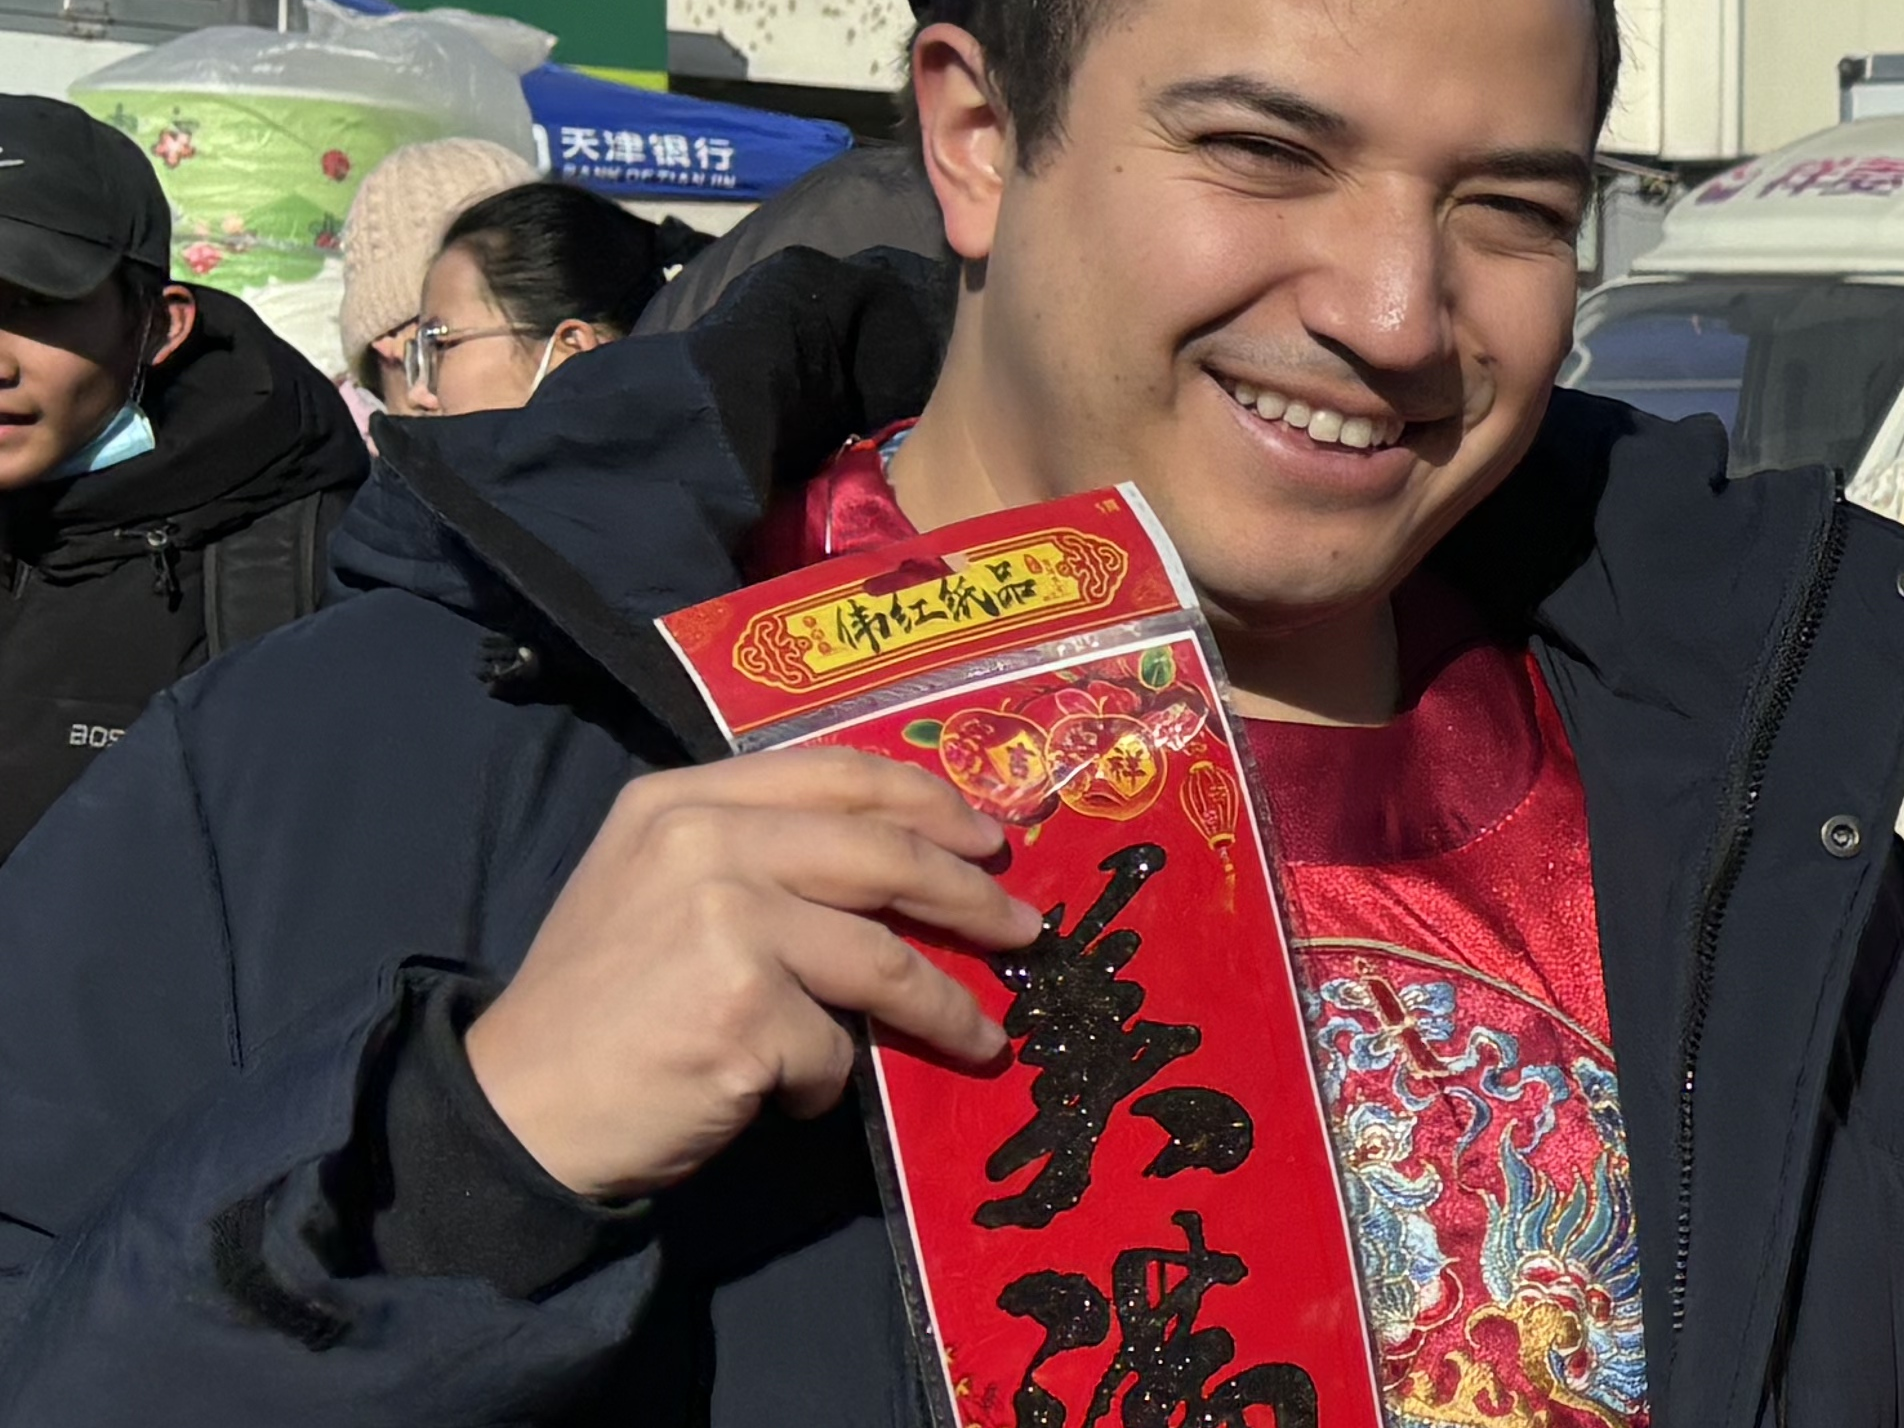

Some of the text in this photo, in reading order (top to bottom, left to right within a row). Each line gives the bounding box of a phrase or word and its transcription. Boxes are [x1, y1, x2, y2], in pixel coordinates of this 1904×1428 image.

[561, 126, 735, 171] 天津银行
[836, 559, 1037, 654] 伟红纸品
